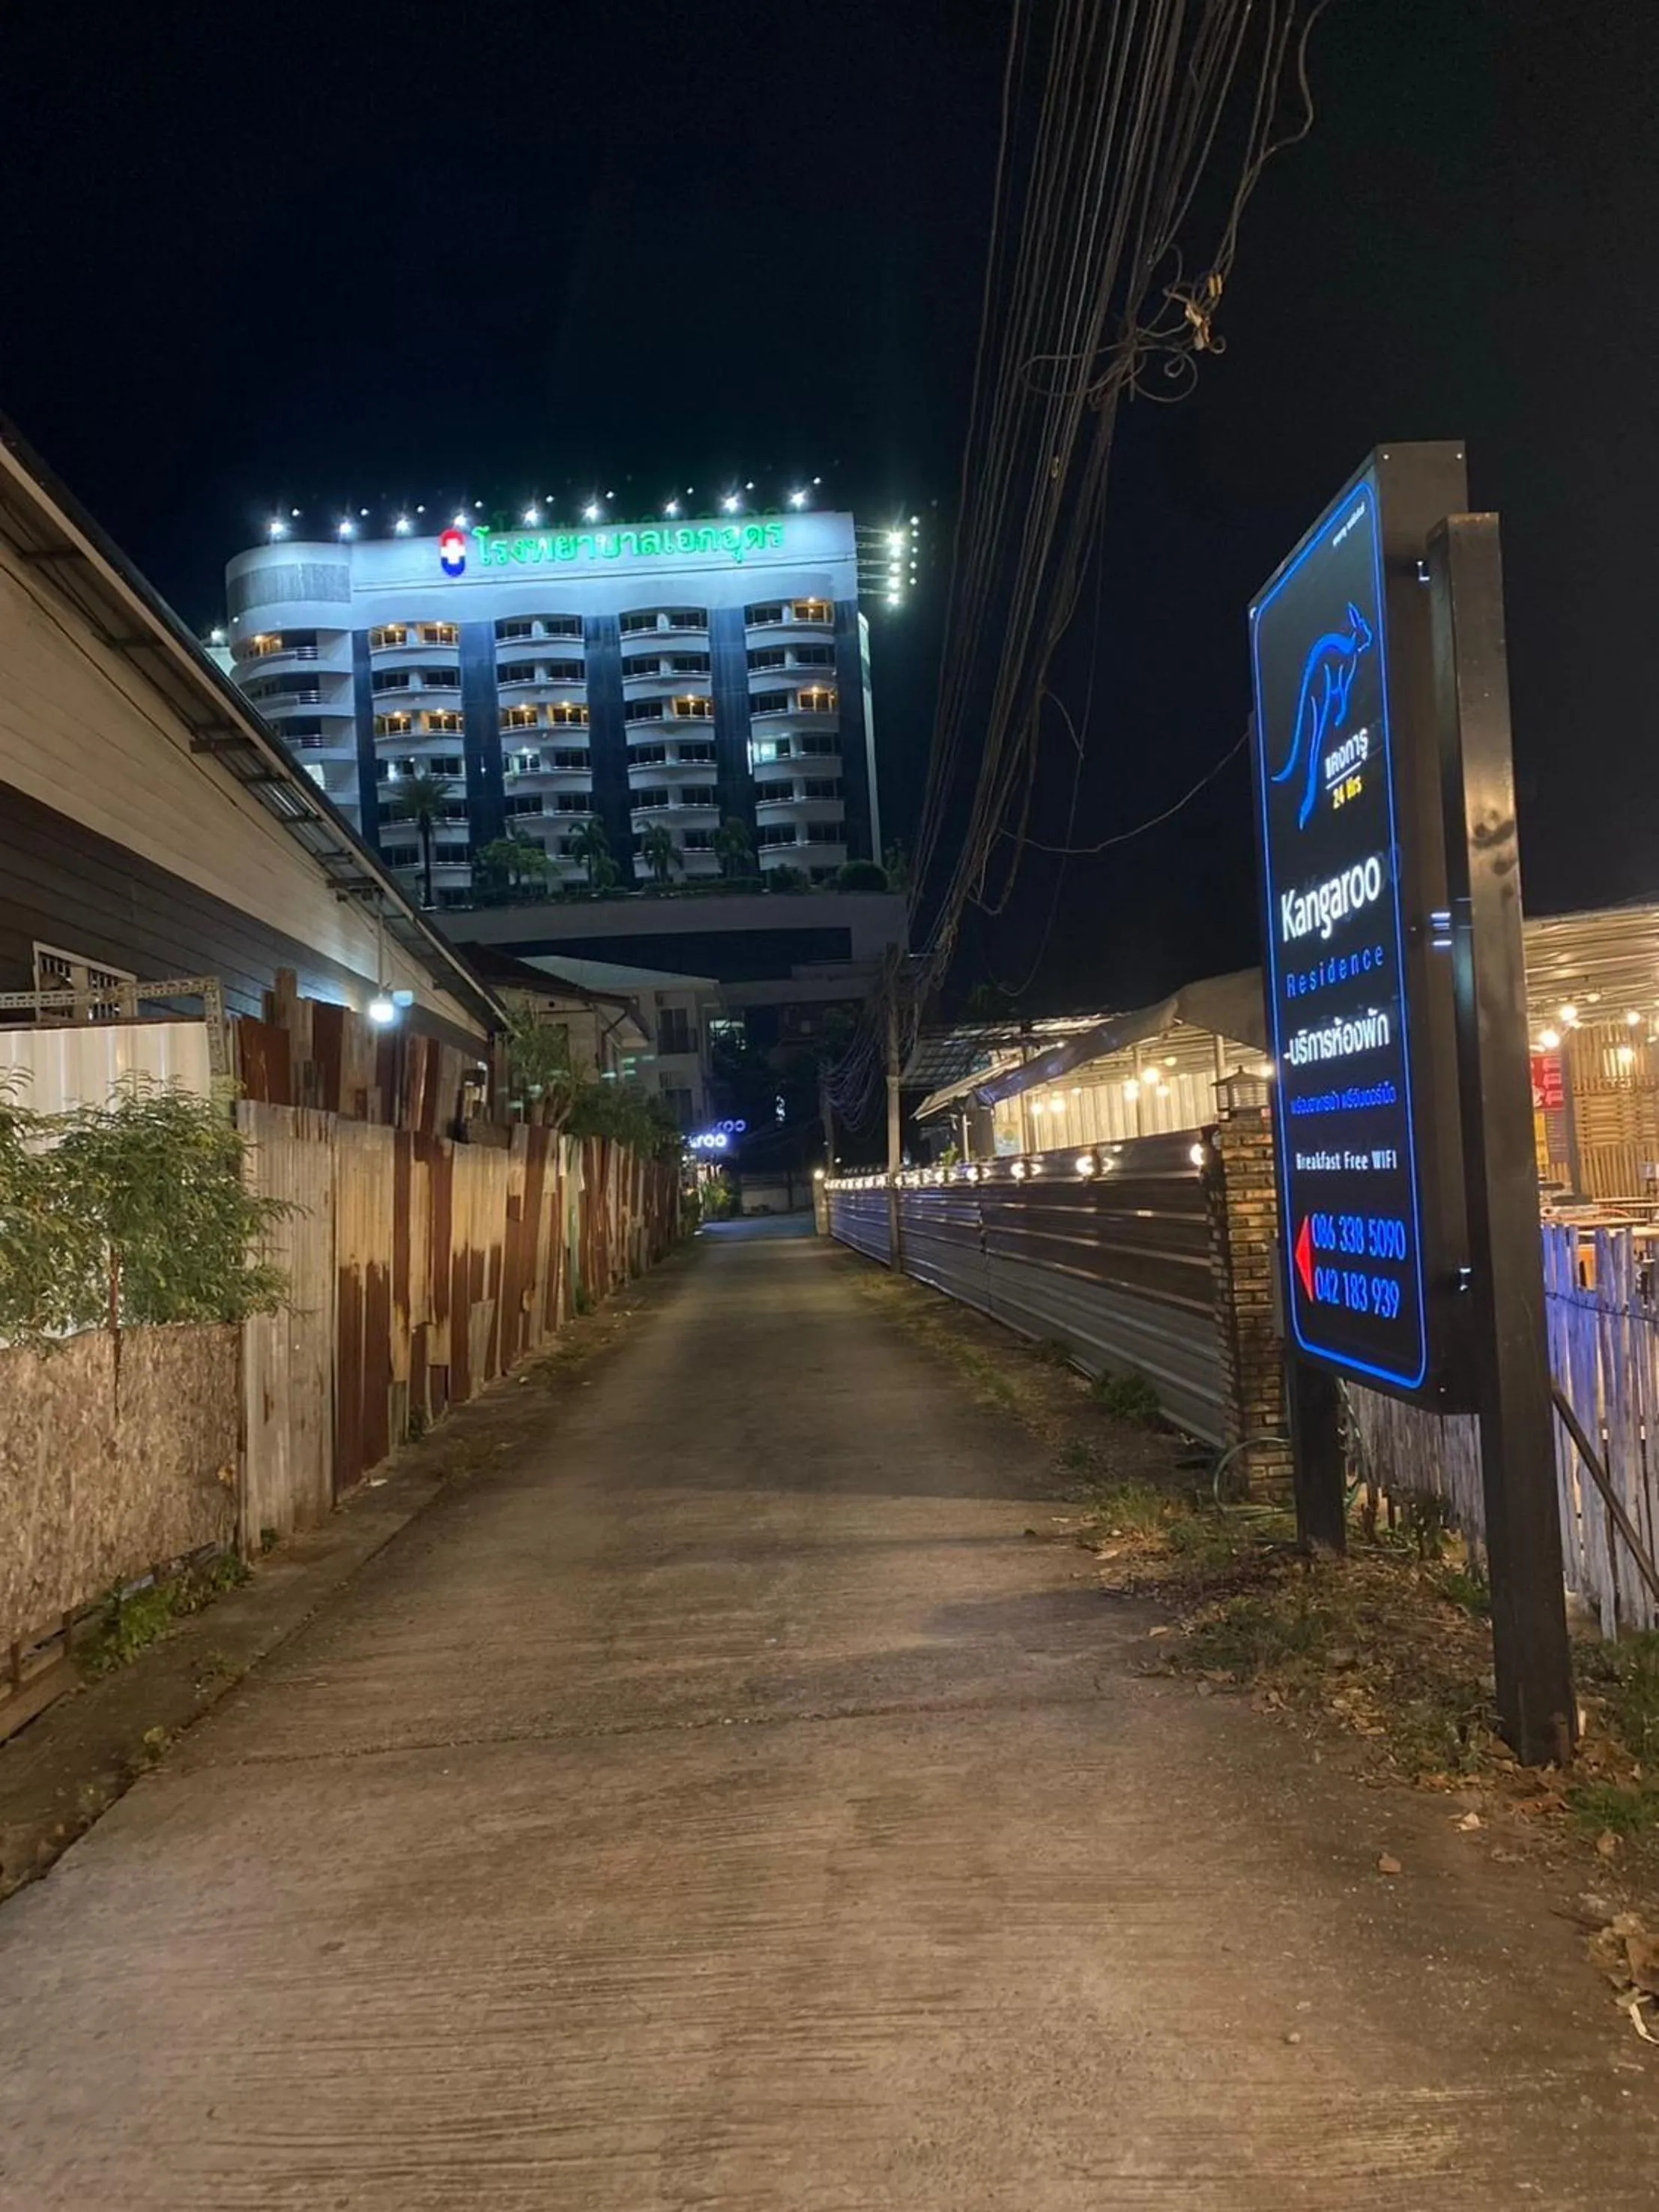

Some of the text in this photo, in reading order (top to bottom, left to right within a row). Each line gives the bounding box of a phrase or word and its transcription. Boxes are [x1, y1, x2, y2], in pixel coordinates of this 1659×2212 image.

[472, 521, 785, 564] โรงพยาบาลเอกอุดร
[1333, 784, 1345, 809] 24
[1281, 856, 1380, 943] Kangaroo
[1287, 946, 1383, 998] Residence
[1296, 1151, 1341, 1170] Breakfast
[1344, 1150, 1368, 1170] Free
[1311, 1213, 1406, 1261] 086 338 5090
[1315, 1266, 1400, 1320] 042 183 939
